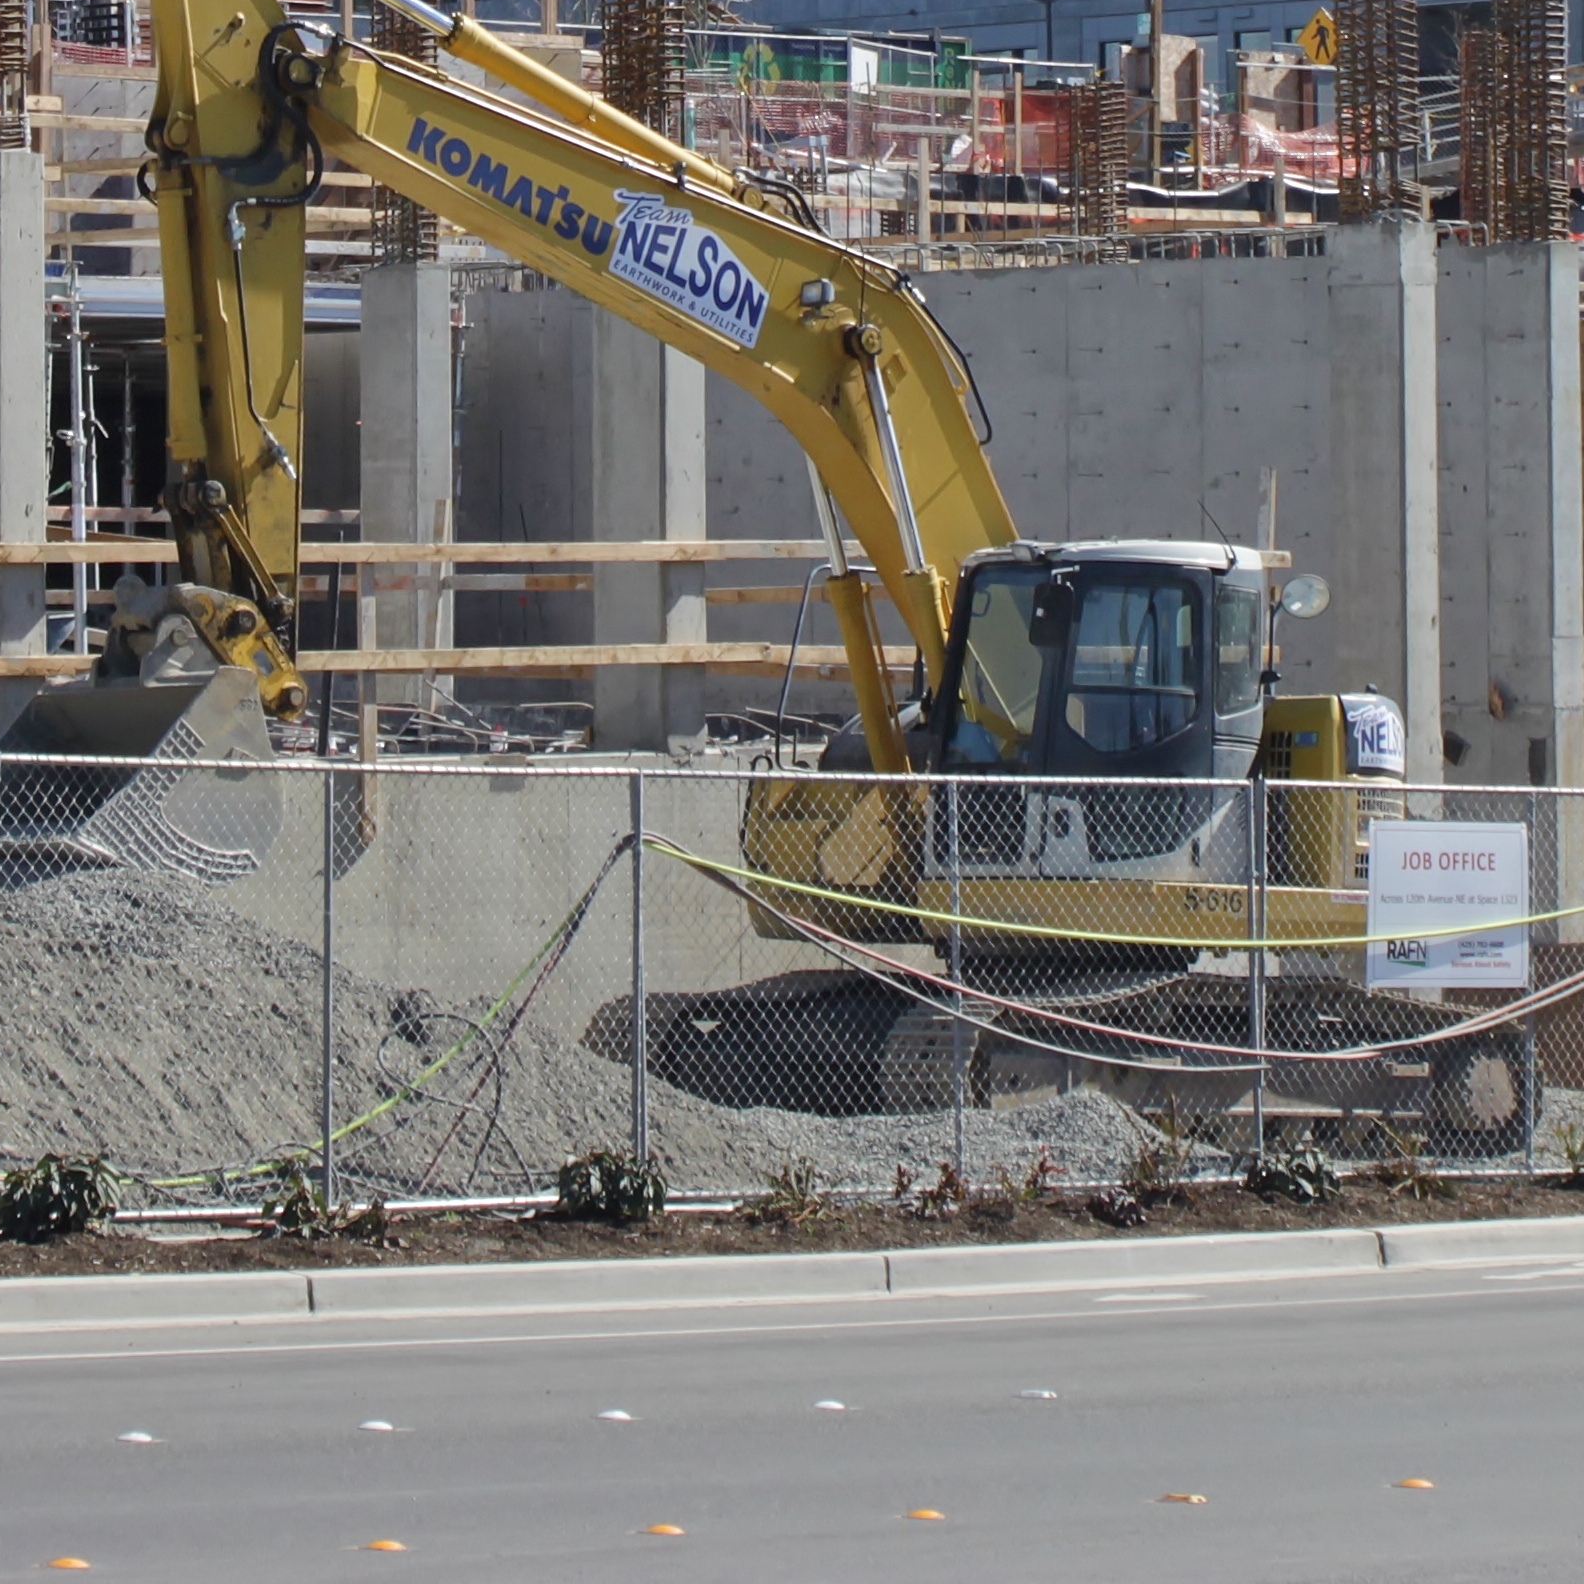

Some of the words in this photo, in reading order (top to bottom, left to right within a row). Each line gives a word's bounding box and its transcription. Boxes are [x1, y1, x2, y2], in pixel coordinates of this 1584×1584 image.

[406, 117, 614, 256] KOMATSU
[617, 191, 692, 225] Team
[619, 221, 765, 329] NELSON
[613, 259, 686, 305] EARTHWORK
[688, 301, 696, 312] &
[700, 307, 754, 343] UTILITIES
[1401, 851, 1432, 871] JOB
[1438, 852, 1496, 872] OFFICE
[1477, 894, 1498, 906] Space
[1387, 939, 1427, 961] RAFN
